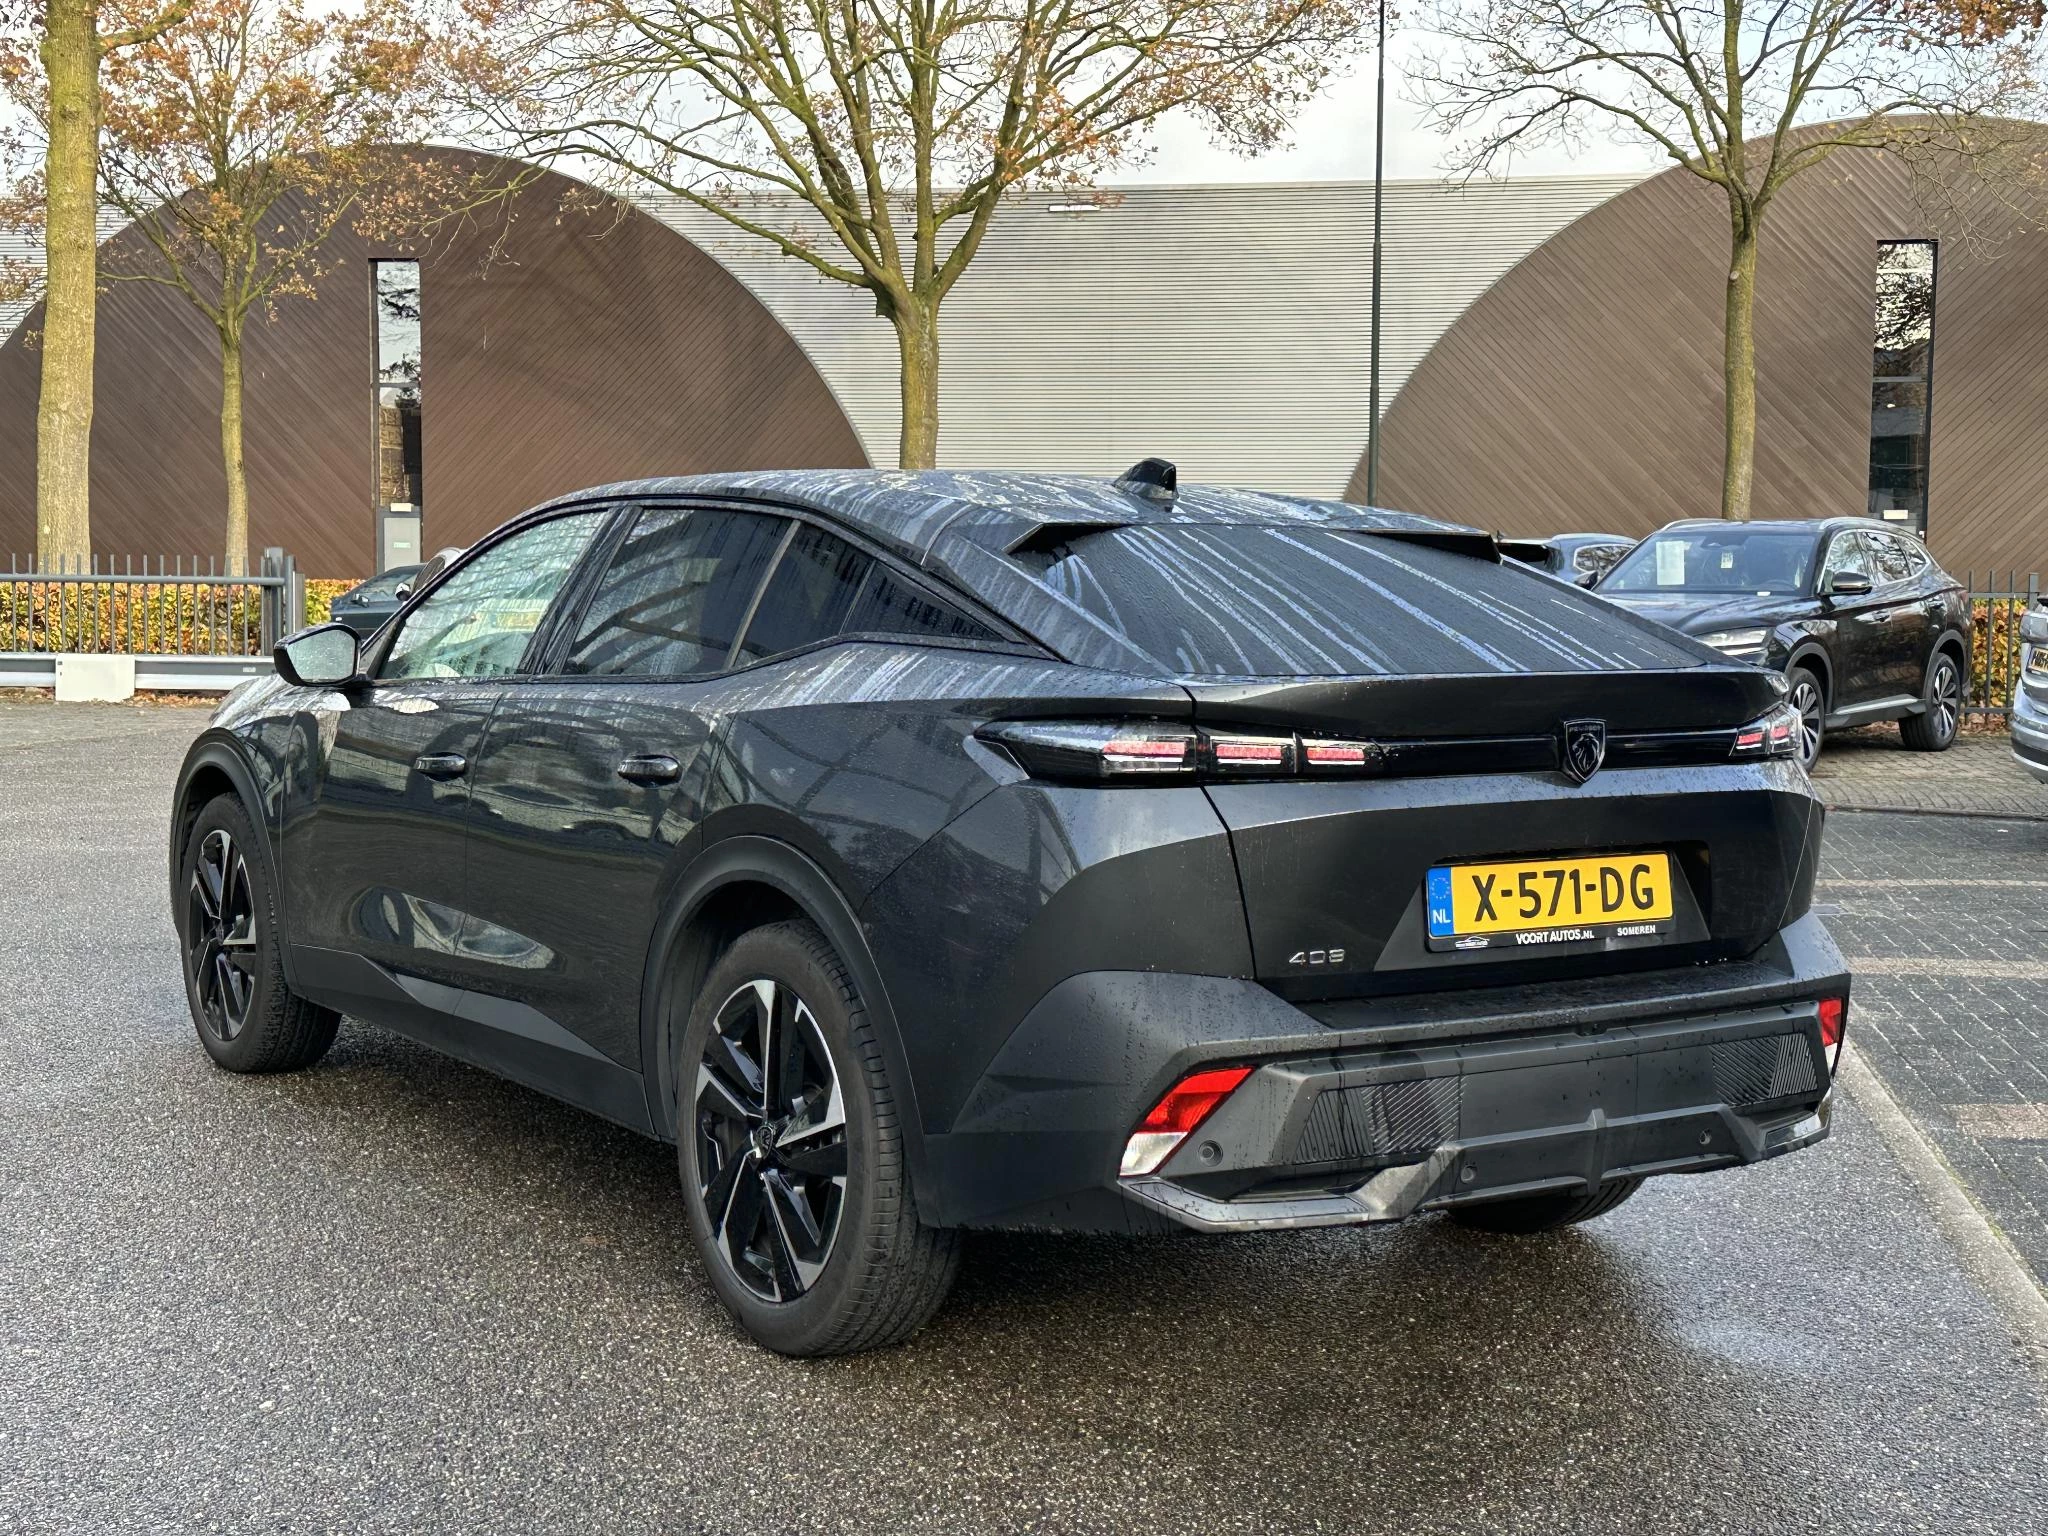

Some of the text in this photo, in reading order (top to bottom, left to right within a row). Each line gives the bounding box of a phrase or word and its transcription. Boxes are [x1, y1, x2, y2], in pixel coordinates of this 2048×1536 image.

[1472, 864, 1655, 922] X-571-DG
[1432, 909, 1451, 924] NL
[1515, 931, 1549, 945] VOORT
[1616, 924, 1656, 937] SOMEREN
[1289, 948, 1345, 965] 408
